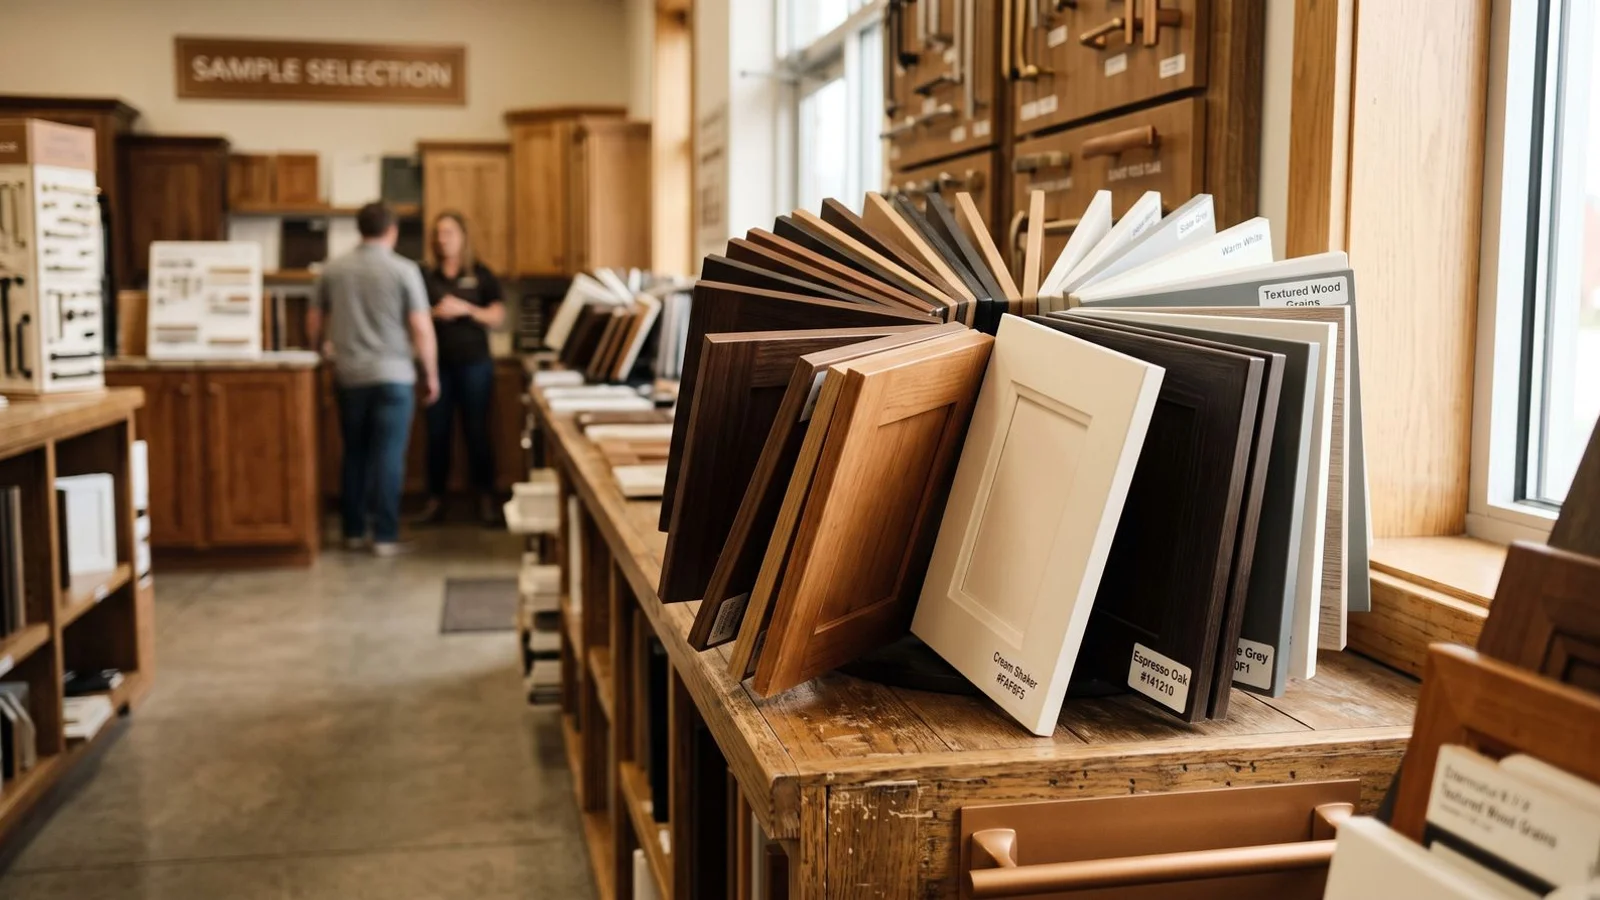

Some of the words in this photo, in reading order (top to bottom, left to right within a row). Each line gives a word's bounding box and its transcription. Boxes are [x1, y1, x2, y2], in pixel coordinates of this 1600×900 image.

[191, 54, 300, 84] SAMPLE
[305, 57, 452, 88] SELECTION
[1221, 241, 1243, 256] Warm
[1244, 233, 1264, 247] White
[1264, 285, 1308, 300] Textured
[1311, 282, 1341, 295] Wood
[1133, 650, 1170, 677] Espresso
[1171, 668, 1188, 686] Oak
[1234, 660, 1250, 674] 0F1
[1236, 647, 1243, 656] e
[1245, 647, 1268, 665] Grey
[993, 651, 1014, 674] Cream
[1014, 666, 1038, 690] Shaker
[1140, 671, 1174, 697] #141210
[1442, 782, 1483, 815] Textured
[1486, 804, 1516, 830] Wood
[1518, 819, 1557, 848] Grains
